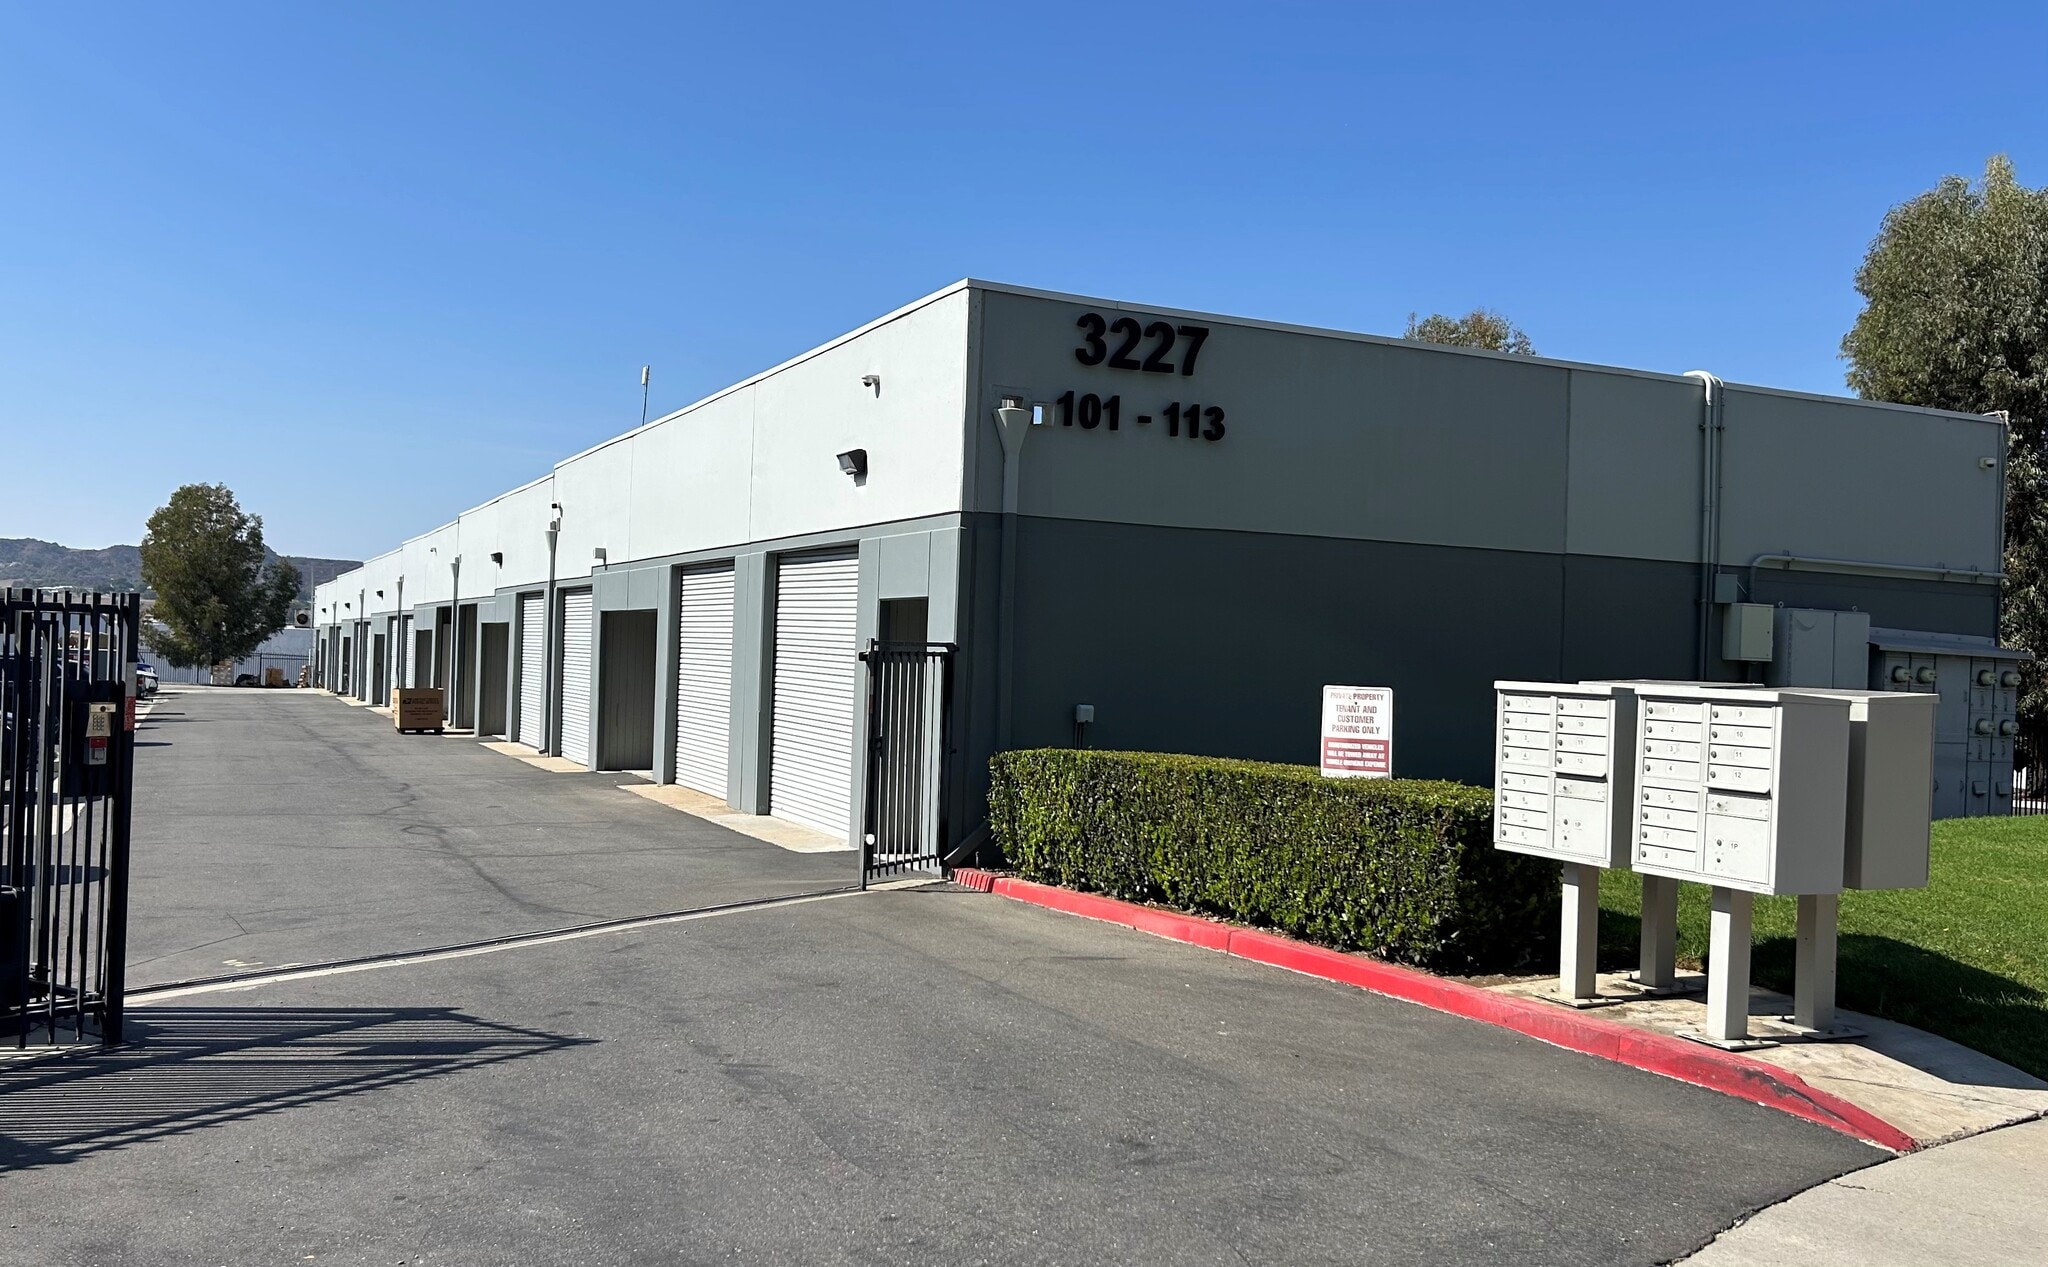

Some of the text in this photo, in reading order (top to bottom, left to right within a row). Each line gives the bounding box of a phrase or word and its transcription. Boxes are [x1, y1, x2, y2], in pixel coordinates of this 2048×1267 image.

[1075, 313, 1209, 376] 3227
[1057, 391, 1120, 431] 101
[1163, 402, 1225, 441] 113
[1330, 692, 1384, 701] PRIVATE PROPERTY
[1336, 705, 1377, 714] TENANT AND
[1337, 715, 1374, 724] CUSTOMER
[1331, 724, 1380, 734] PARKING ONLY
